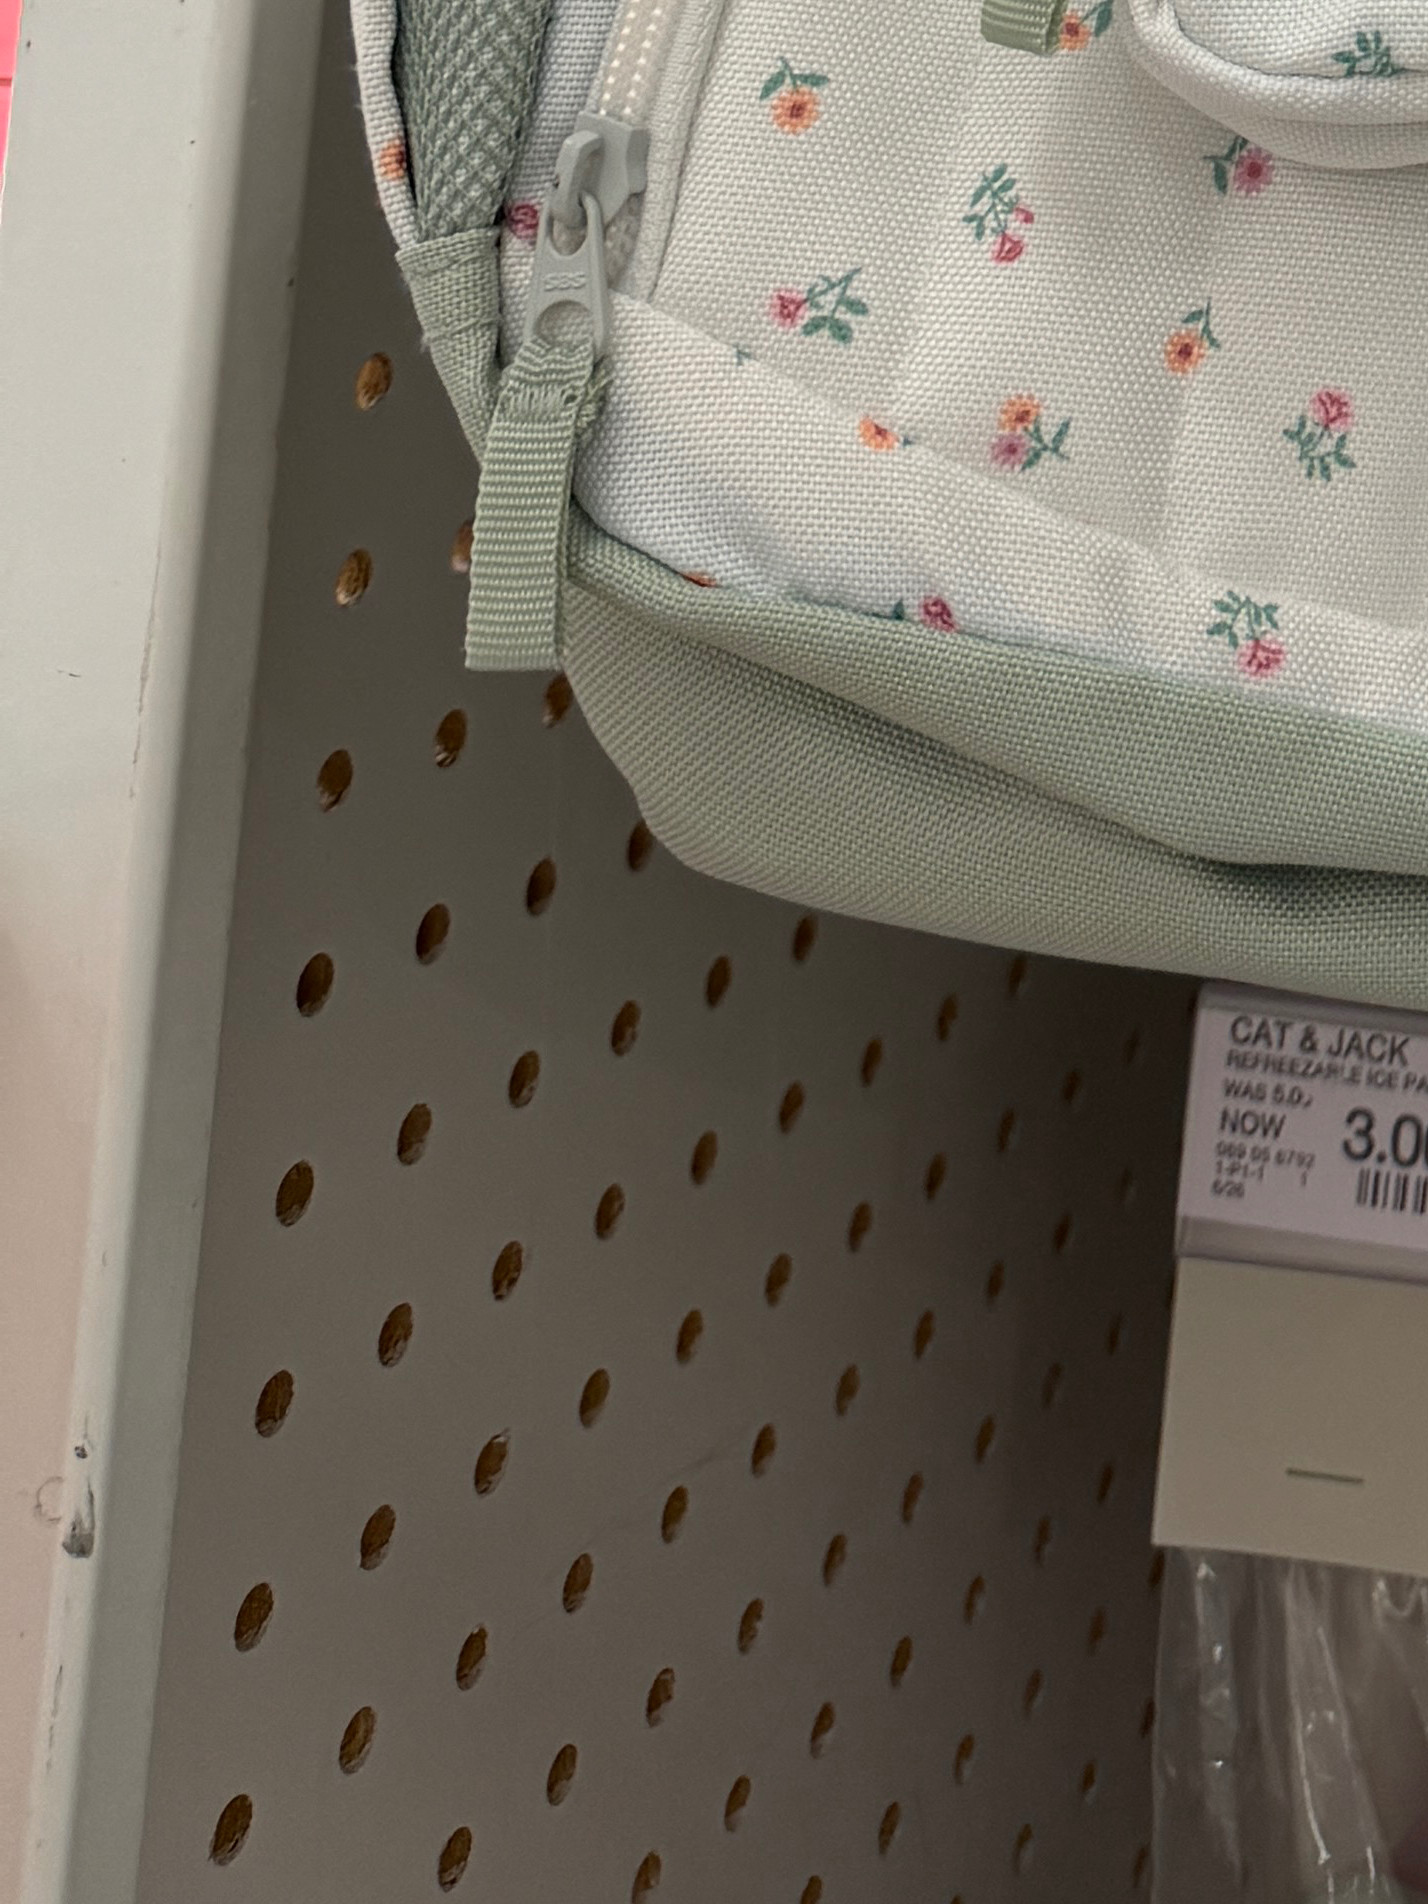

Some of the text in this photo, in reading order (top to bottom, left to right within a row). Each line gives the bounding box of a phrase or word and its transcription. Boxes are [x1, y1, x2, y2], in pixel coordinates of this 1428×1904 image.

[1231, 1016, 1410, 1067] CAT & JACK
[1223, 1078, 1266, 1102] WAS
[1366, 1066, 1398, 1089] ICE
[1219, 1107, 1286, 1140] NOW
